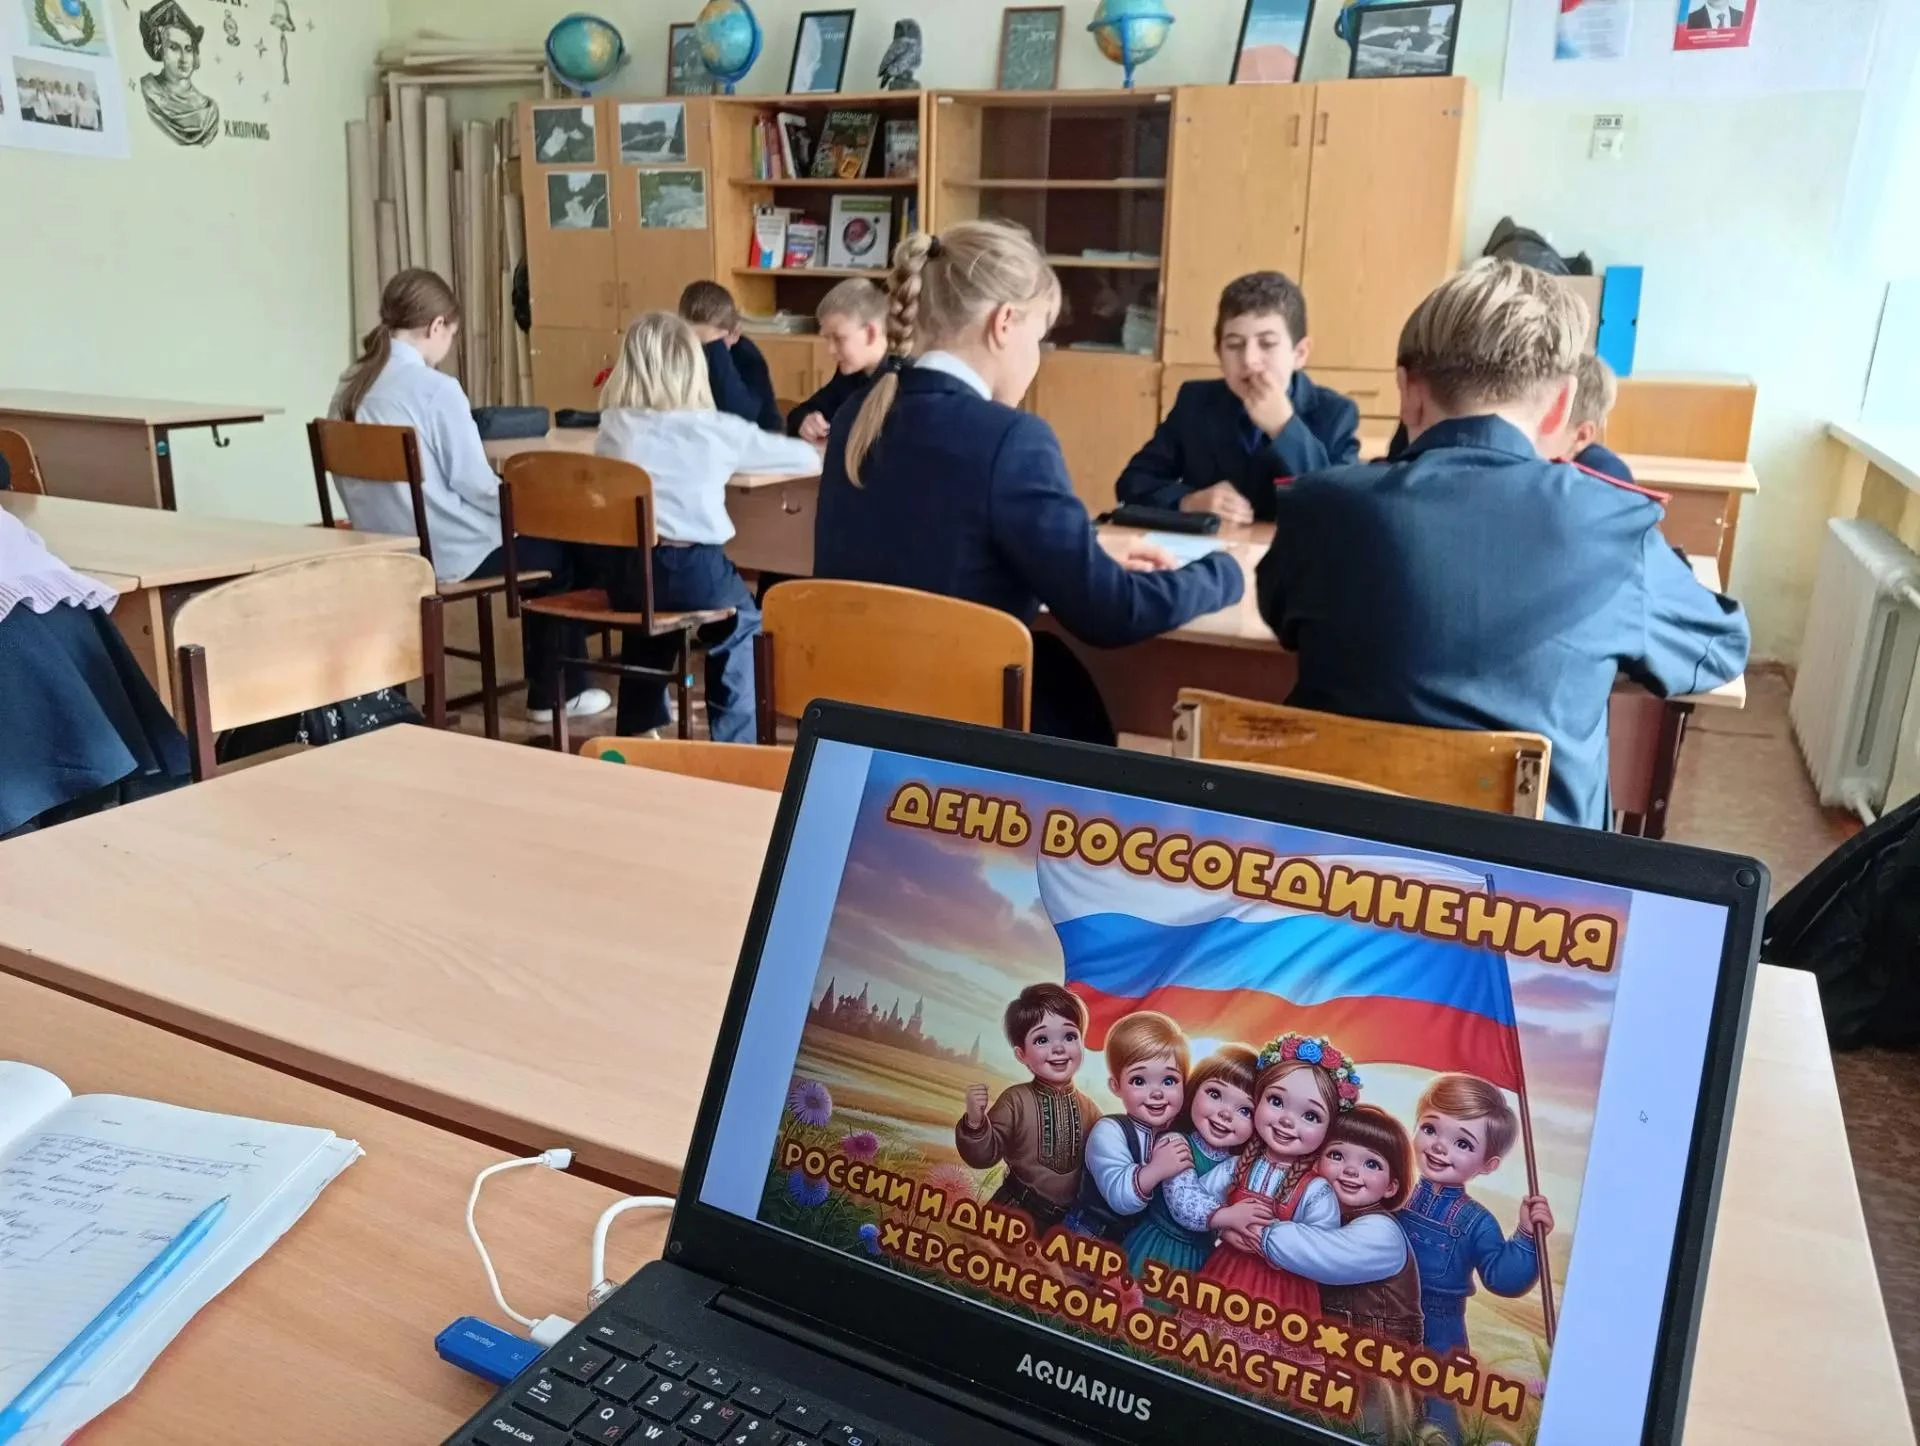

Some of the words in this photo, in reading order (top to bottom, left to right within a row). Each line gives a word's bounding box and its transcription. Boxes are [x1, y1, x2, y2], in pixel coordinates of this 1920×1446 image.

[888, 784, 1030, 846] ДЕНЬ
[1042, 811, 1616, 971] ВОССОЕДИНЕНИЯ
[784, 1142, 913, 1208] РОССИИ
[918, 1187, 944, 1219] И
[1143, 1264, 1476, 1401] ЗАПОРОЖСКОЙ
[1487, 1379, 1520, 1417] И
[881, 1223, 1119, 1330] ХЕРСОНСКОЙ
[1128, 1312, 1354, 1415] ОБЛАСТЕЙ
[599, 1326, 615, 1336] esc
[537, 1379, 553, 1392] Tab
[604, 1376, 615, 1385] 1
[1016, 1353, 1152, 1421] AQUARIUS
[645, 1395, 660, 1406] 2
[600, 1407, 615, 1420] Q
[690, 1414, 702, 1424] 3
[492, 1418, 515, 1434] Caps
[514, 1428, 536, 1443] Lock
[645, 1425, 664, 1440] W
[735, 1434, 748, 1445] 4
